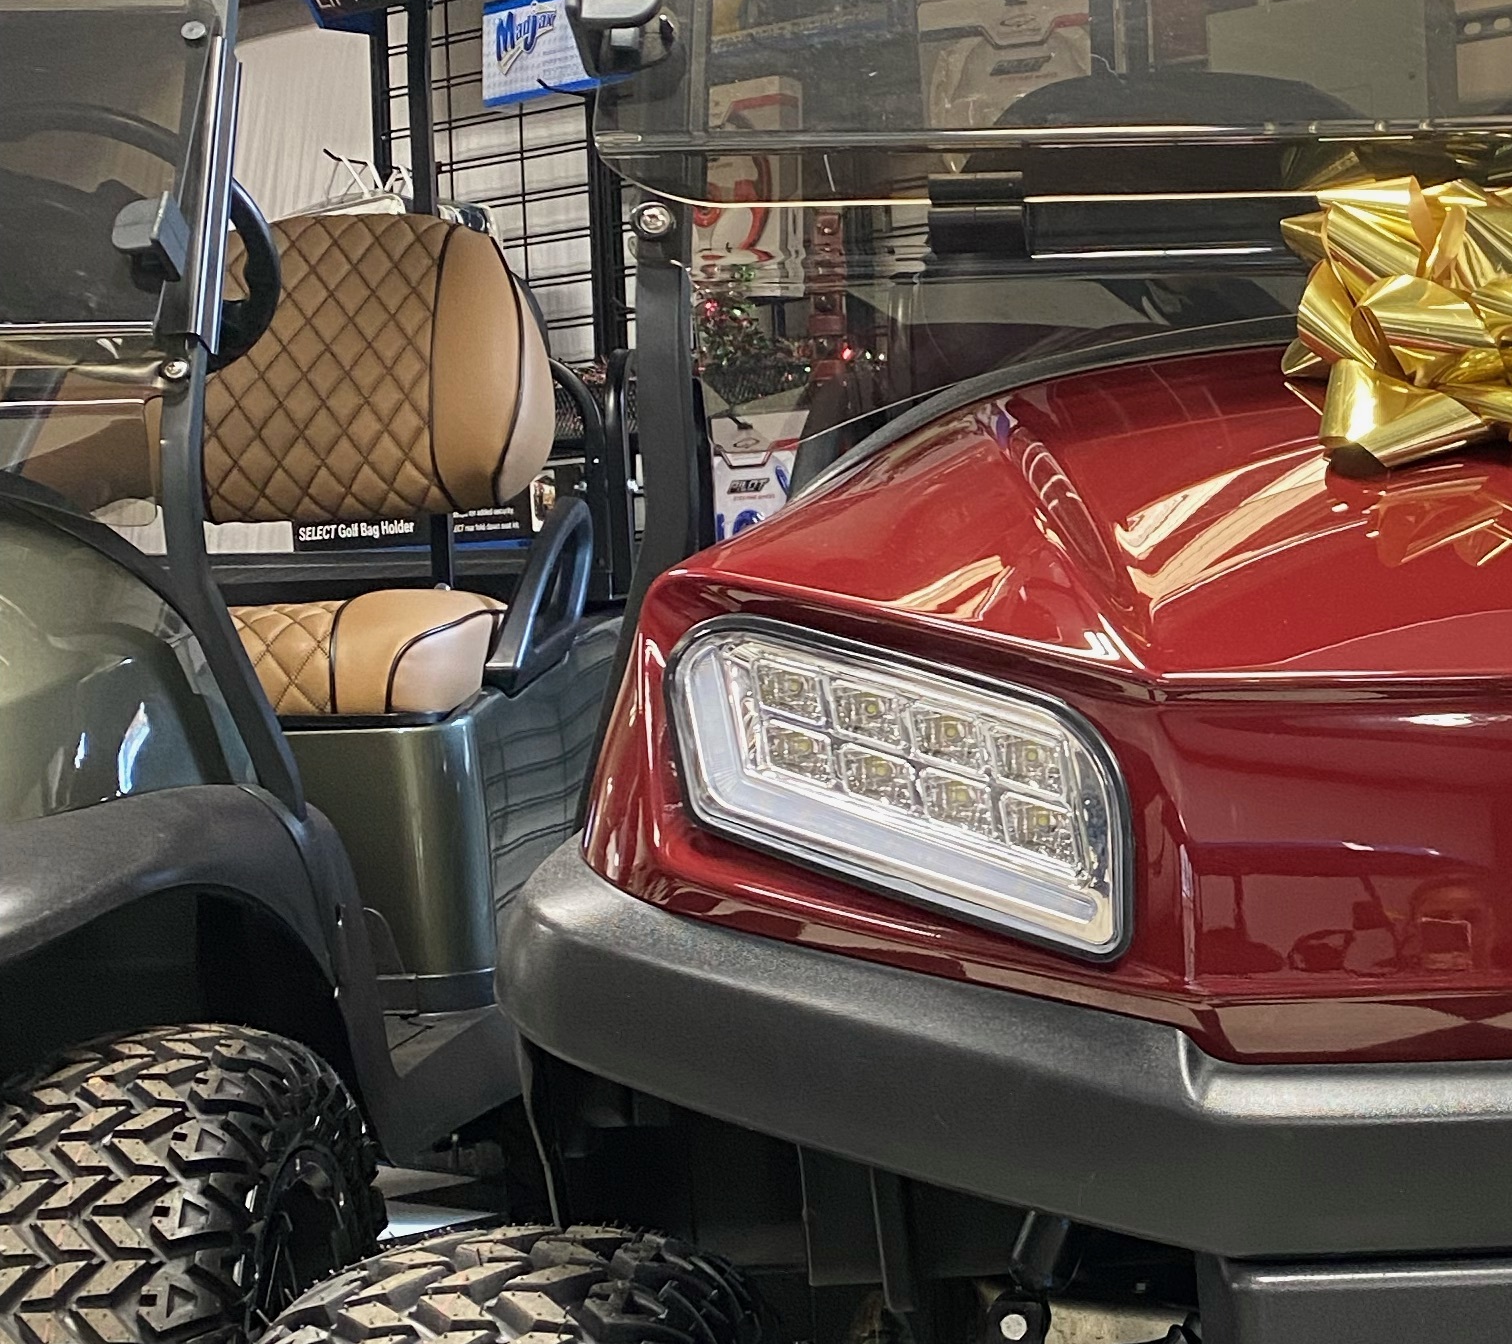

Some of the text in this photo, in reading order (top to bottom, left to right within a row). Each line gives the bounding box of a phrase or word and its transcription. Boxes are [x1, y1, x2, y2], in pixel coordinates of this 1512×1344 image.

[299, 519, 415, 541] SELECT Golf Bag Holder
